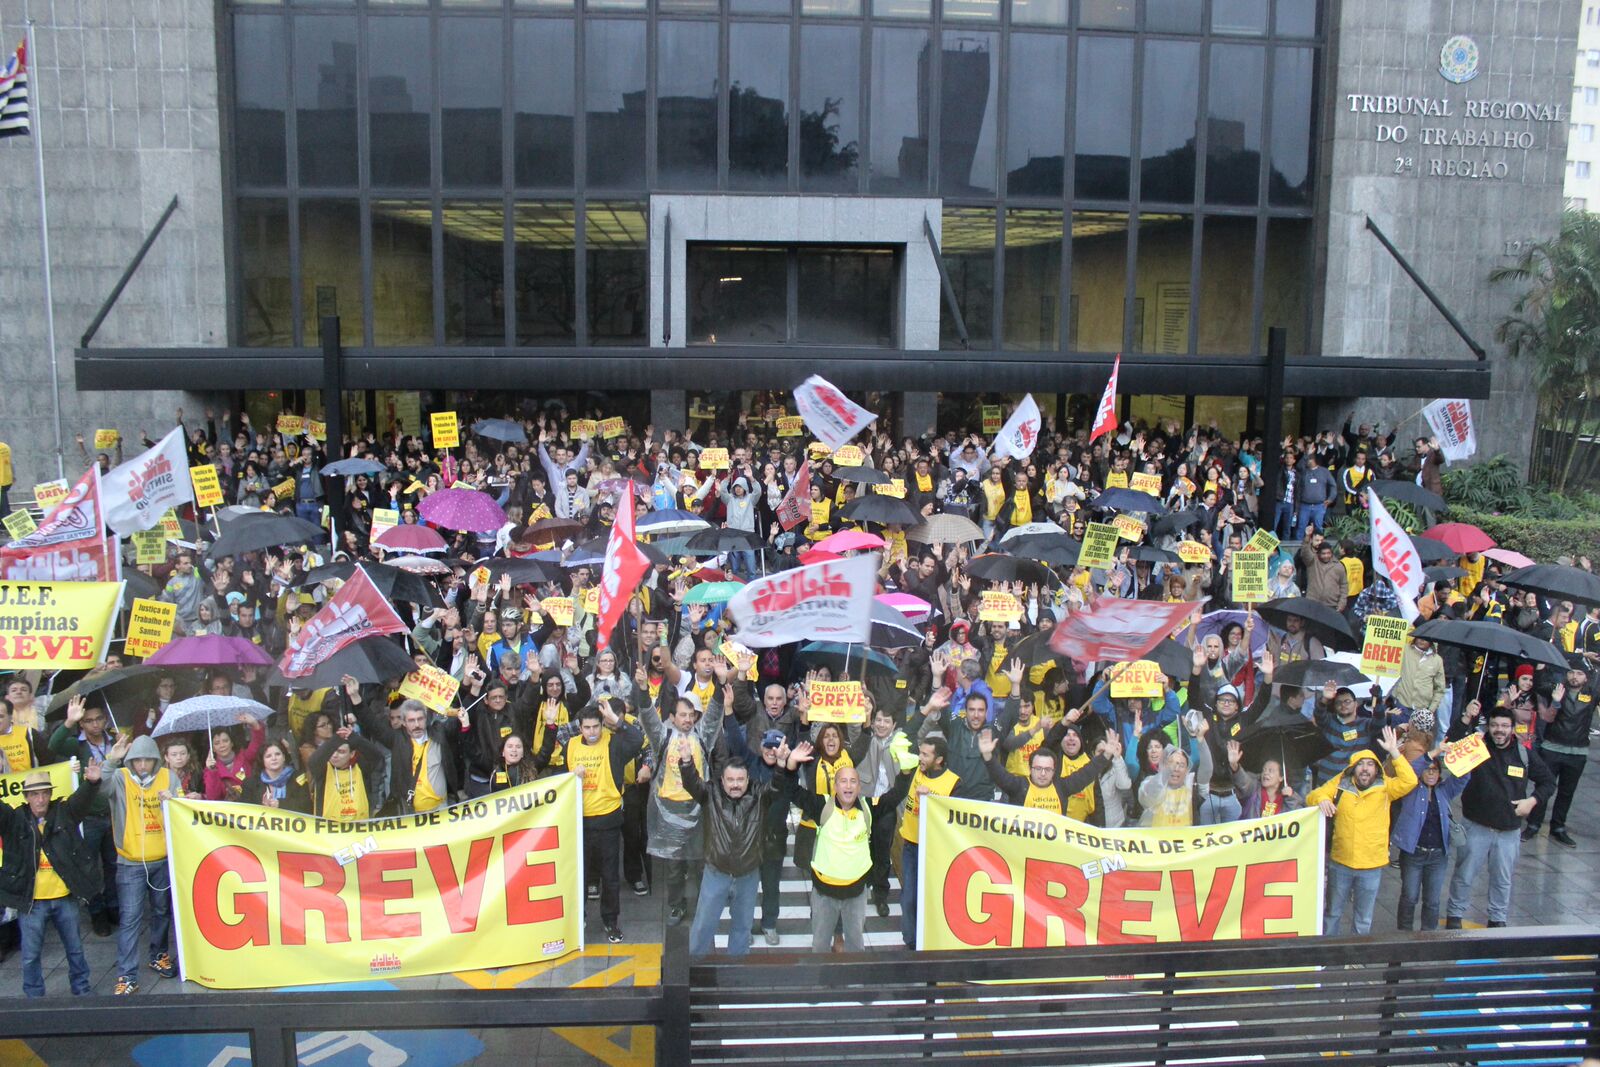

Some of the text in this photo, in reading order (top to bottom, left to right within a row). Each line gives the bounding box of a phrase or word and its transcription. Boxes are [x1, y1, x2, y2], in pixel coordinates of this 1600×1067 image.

[1347, 94, 1566, 122] TRIBUNAL REGIONAL
[1376, 125, 1535, 149] DO TRABALHO
[1133, 479, 1161, 490] GREVE
[1114, 518, 1144, 535] GREVE
[1180, 545, 1211, 555] GREVE
[138, 604, 161, 614] Justiça
[134, 615, 161, 626] Trabalho
[127, 637, 140, 647] EM
[139, 627, 161, 637] Santos
[1373, 628, 1402, 640] FEDERAL
[1363, 643, 1402, 664] GREVE
[407, 671, 456, 701] GREVE
[1112, 670, 1160, 683] GREVE
[811, 683, 851, 692] ESTAMOS
[811, 691, 865, 707] GREVE
[1445, 734, 1481, 764] GREV
[0, 778, 25, 798] de
[191, 809, 307, 834] JUDICIÁRIO
[315, 816, 408, 834] FEDERAL
[415, 809, 441, 827] DE
[495, 789, 557, 816] PAULO
[947, 808, 1301, 855] JUDICIÁRIO FEDERAL DE SÃO PAULO
[332, 834, 380, 867] EM
[1080, 853, 1129, 881] EM
[191, 825, 565, 951] GREVE
[942, 845, 1299, 949] GREVE
